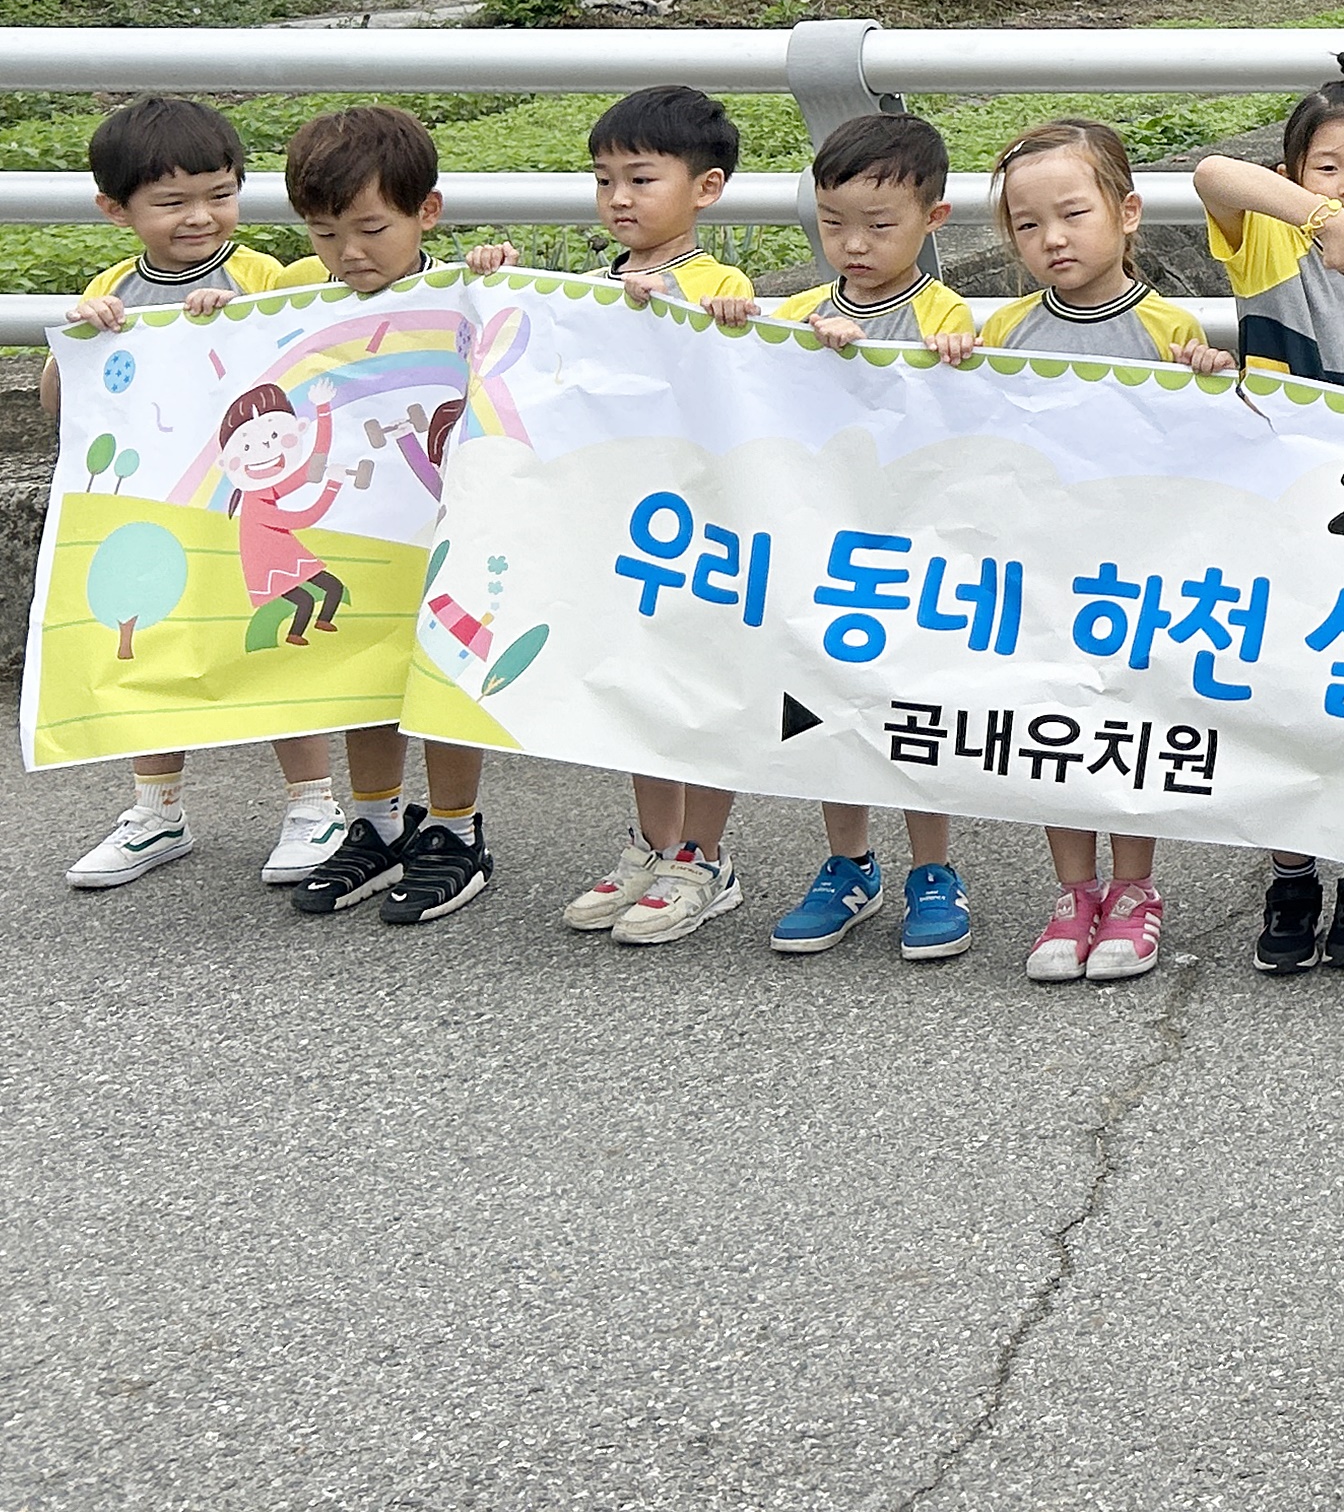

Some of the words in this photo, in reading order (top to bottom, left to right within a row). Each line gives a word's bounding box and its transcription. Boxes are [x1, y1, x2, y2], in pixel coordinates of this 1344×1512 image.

[614, 491, 772, 628] 우리
[813, 530, 1024, 664] 동네
[1072, 562, 1270, 701] 하천
[882, 699, 1220, 796] 곰내유치원
[841, 885, 868, 914] N
